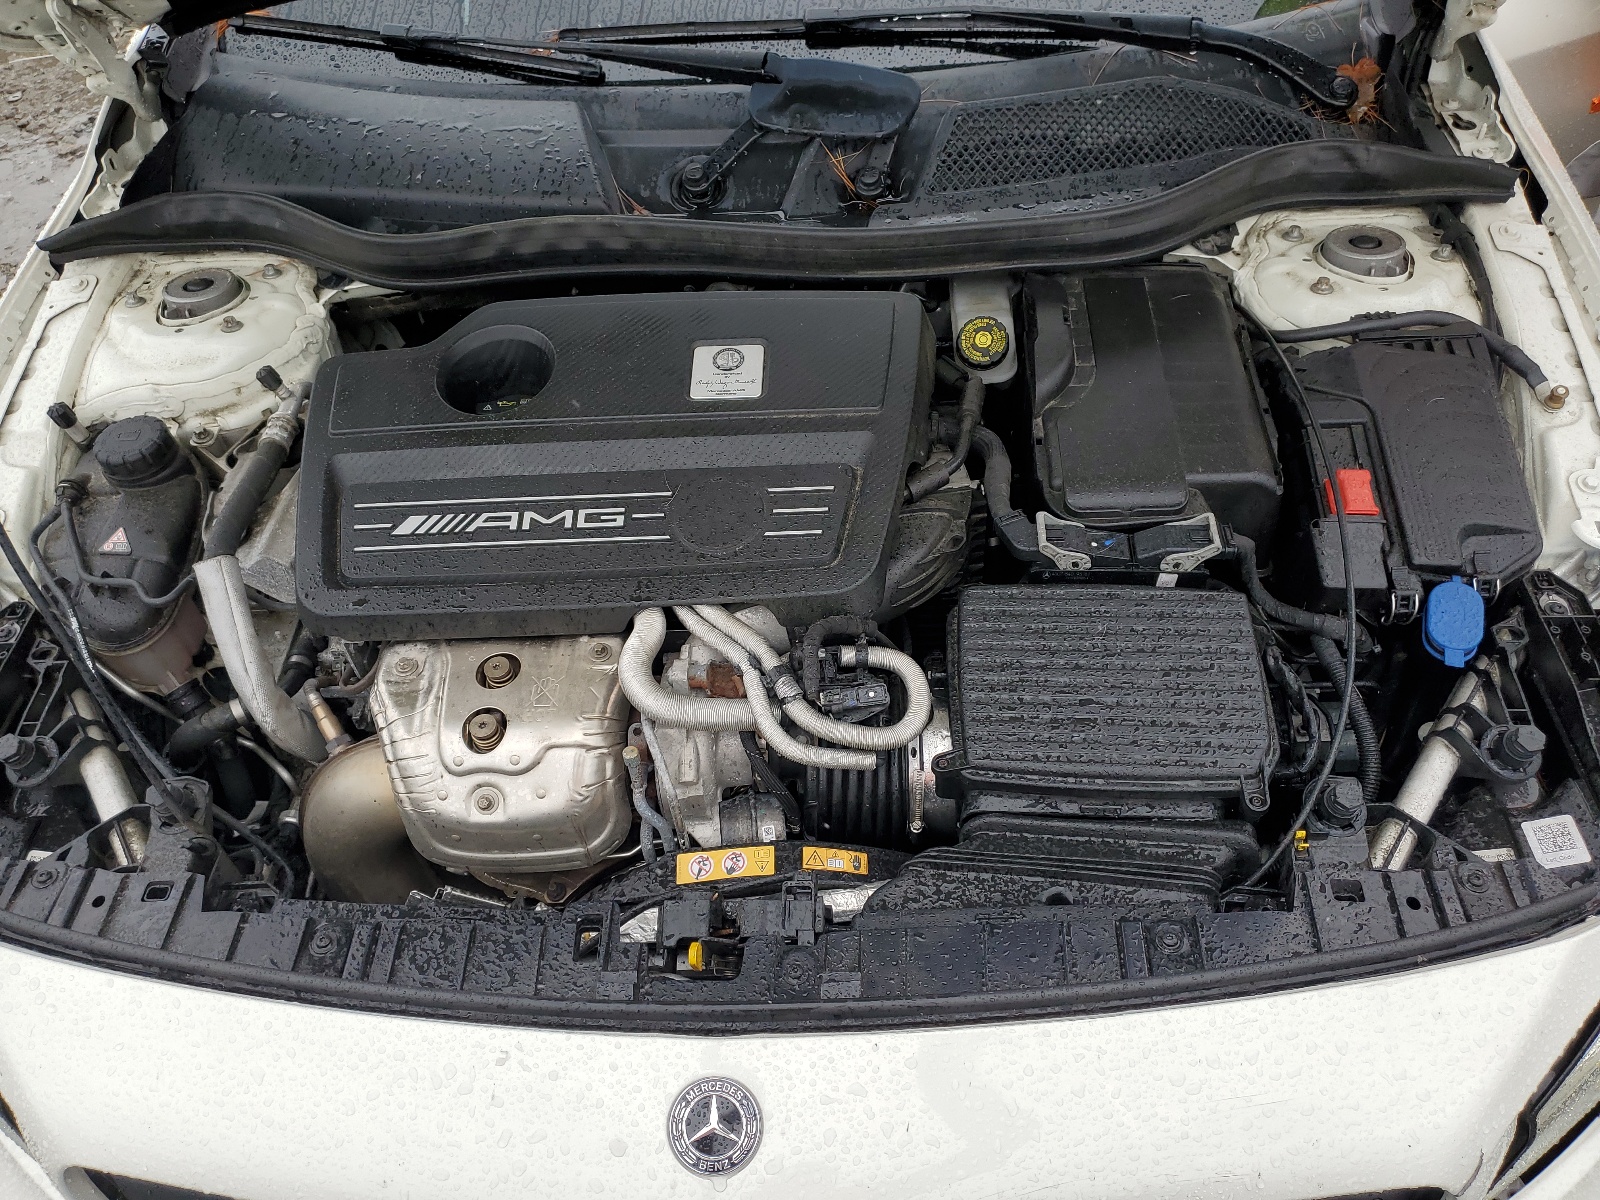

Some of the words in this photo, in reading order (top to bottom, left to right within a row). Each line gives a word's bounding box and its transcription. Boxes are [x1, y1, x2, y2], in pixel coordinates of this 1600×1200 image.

[468, 507, 625, 533] AMG
[685, 1082, 743, 1101] MERCEDES
[699, 1160, 730, 1171] BENZ
